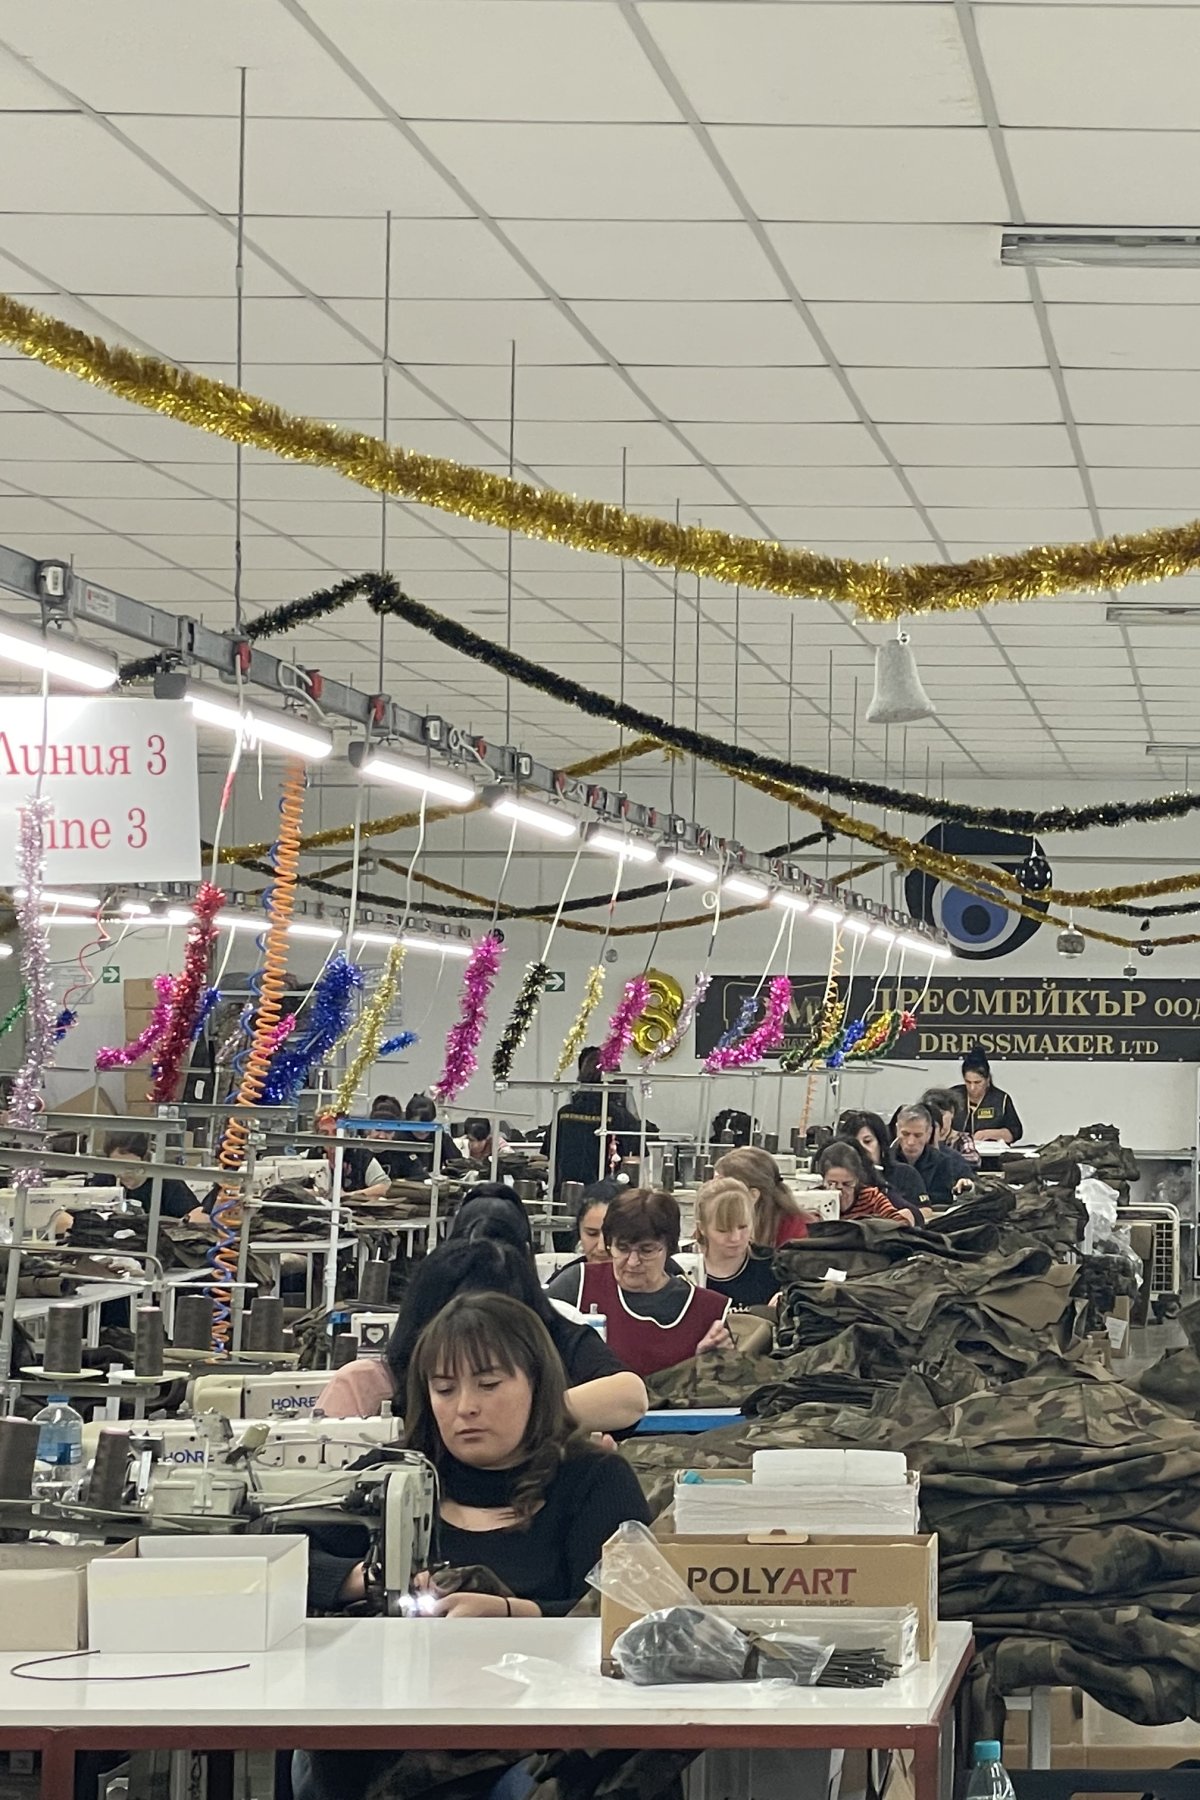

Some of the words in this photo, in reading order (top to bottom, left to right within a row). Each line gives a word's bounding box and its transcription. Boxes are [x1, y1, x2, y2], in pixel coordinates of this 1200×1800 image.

[146, 734, 167, 776] 3
[127, 807, 147, 849] 3
[919, 1032, 1115, 1055] DRESSMAKER
[1120, 1040, 1159, 1055] LTD
[271, 1395, 319, 1409] HONRE
[687, 1567, 857, 1595] POLYART
